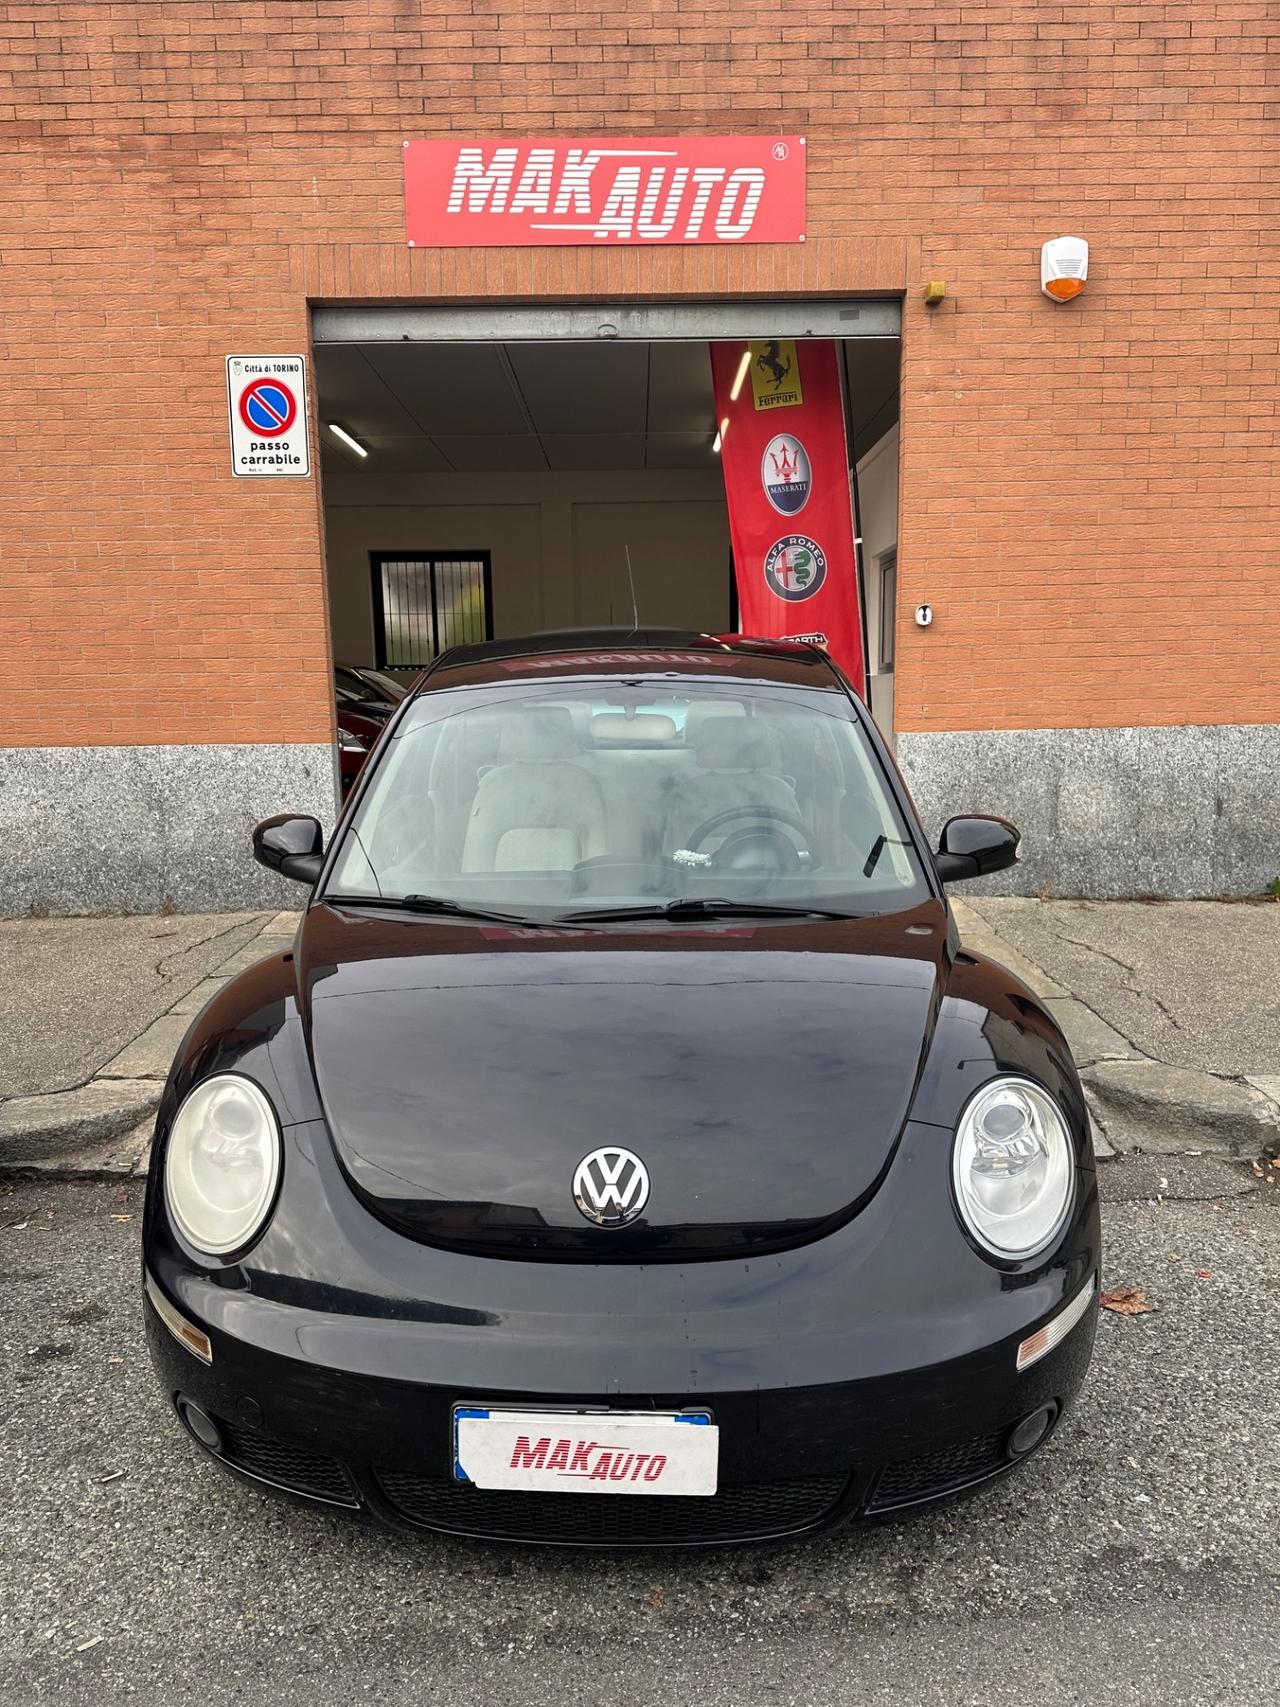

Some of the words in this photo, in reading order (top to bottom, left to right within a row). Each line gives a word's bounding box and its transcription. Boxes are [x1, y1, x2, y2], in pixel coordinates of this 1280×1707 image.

[244, 364, 263, 373] Città
[264, 364, 271, 373] di
[273, 364, 299, 373] TORINO
[758, 391, 798, 407] Ferrari
[250, 442, 290, 452] passo
[240, 454, 301, 465] carrabile
[770, 483, 807, 494] MASERATI
[767, 543, 785, 572] ALFA
[789, 537, 824, 567] ROMEO
